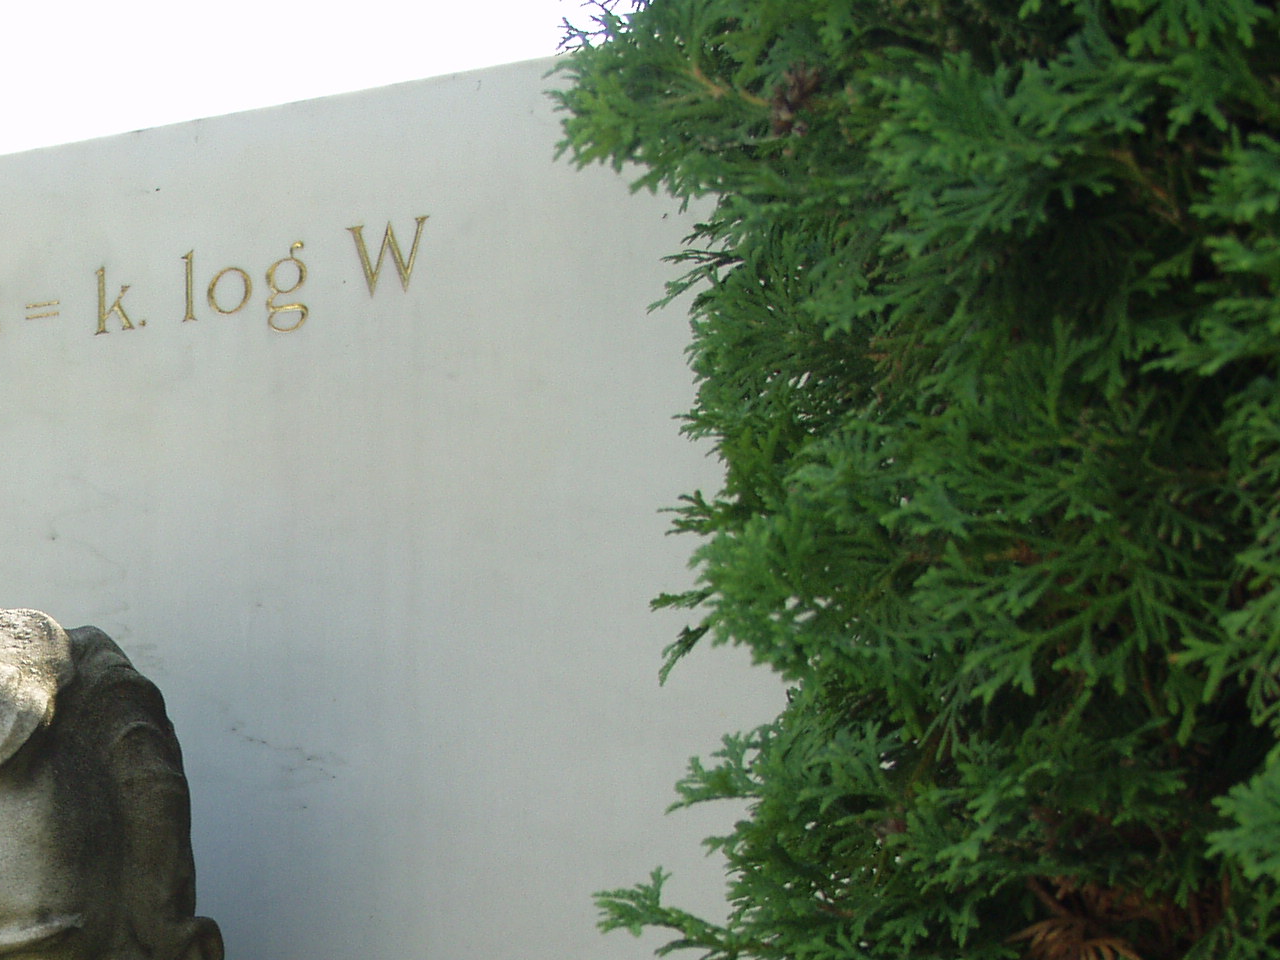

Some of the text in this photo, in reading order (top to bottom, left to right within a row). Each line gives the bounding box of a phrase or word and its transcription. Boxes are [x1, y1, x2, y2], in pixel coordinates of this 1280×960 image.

[25, 299, 60, 320] =
[181, 240, 309, 333] log
[346, 214, 430, 298] W
